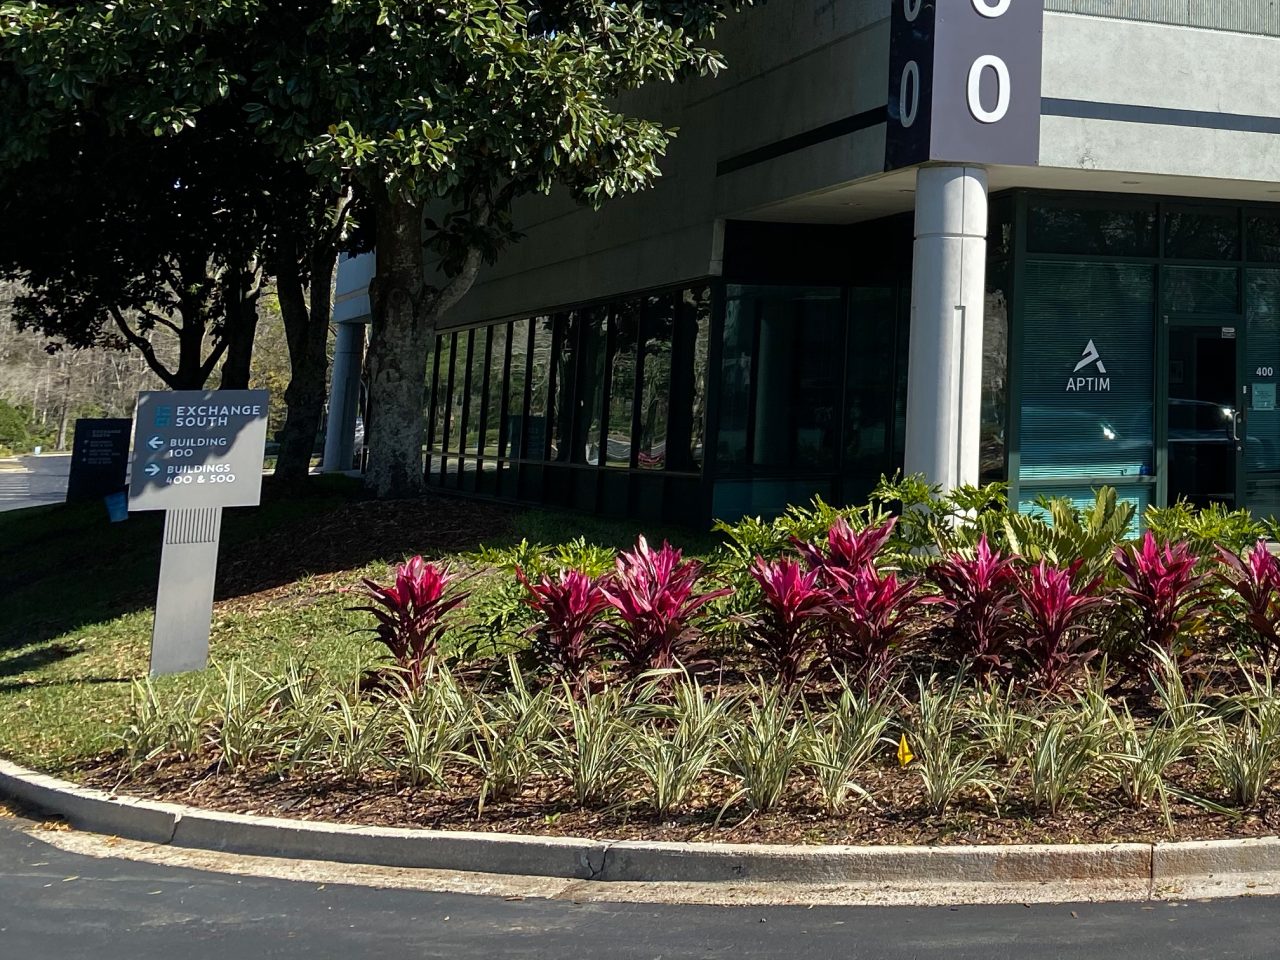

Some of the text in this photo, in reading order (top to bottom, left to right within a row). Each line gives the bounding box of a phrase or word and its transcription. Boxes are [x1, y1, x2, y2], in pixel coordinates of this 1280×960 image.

[1256, 366, 1273, 377] 400
[1066, 377, 1111, 392] APTIM
[176, 405, 261, 416] EXCHANGE
[175, 416, 228, 427] SOUTH
[170, 437, 227, 447] BUILDING
[168, 448, 194, 458] 100
[167, 463, 231, 474] BUILDINGS
[166, 474, 236, 485] 400 & 500
